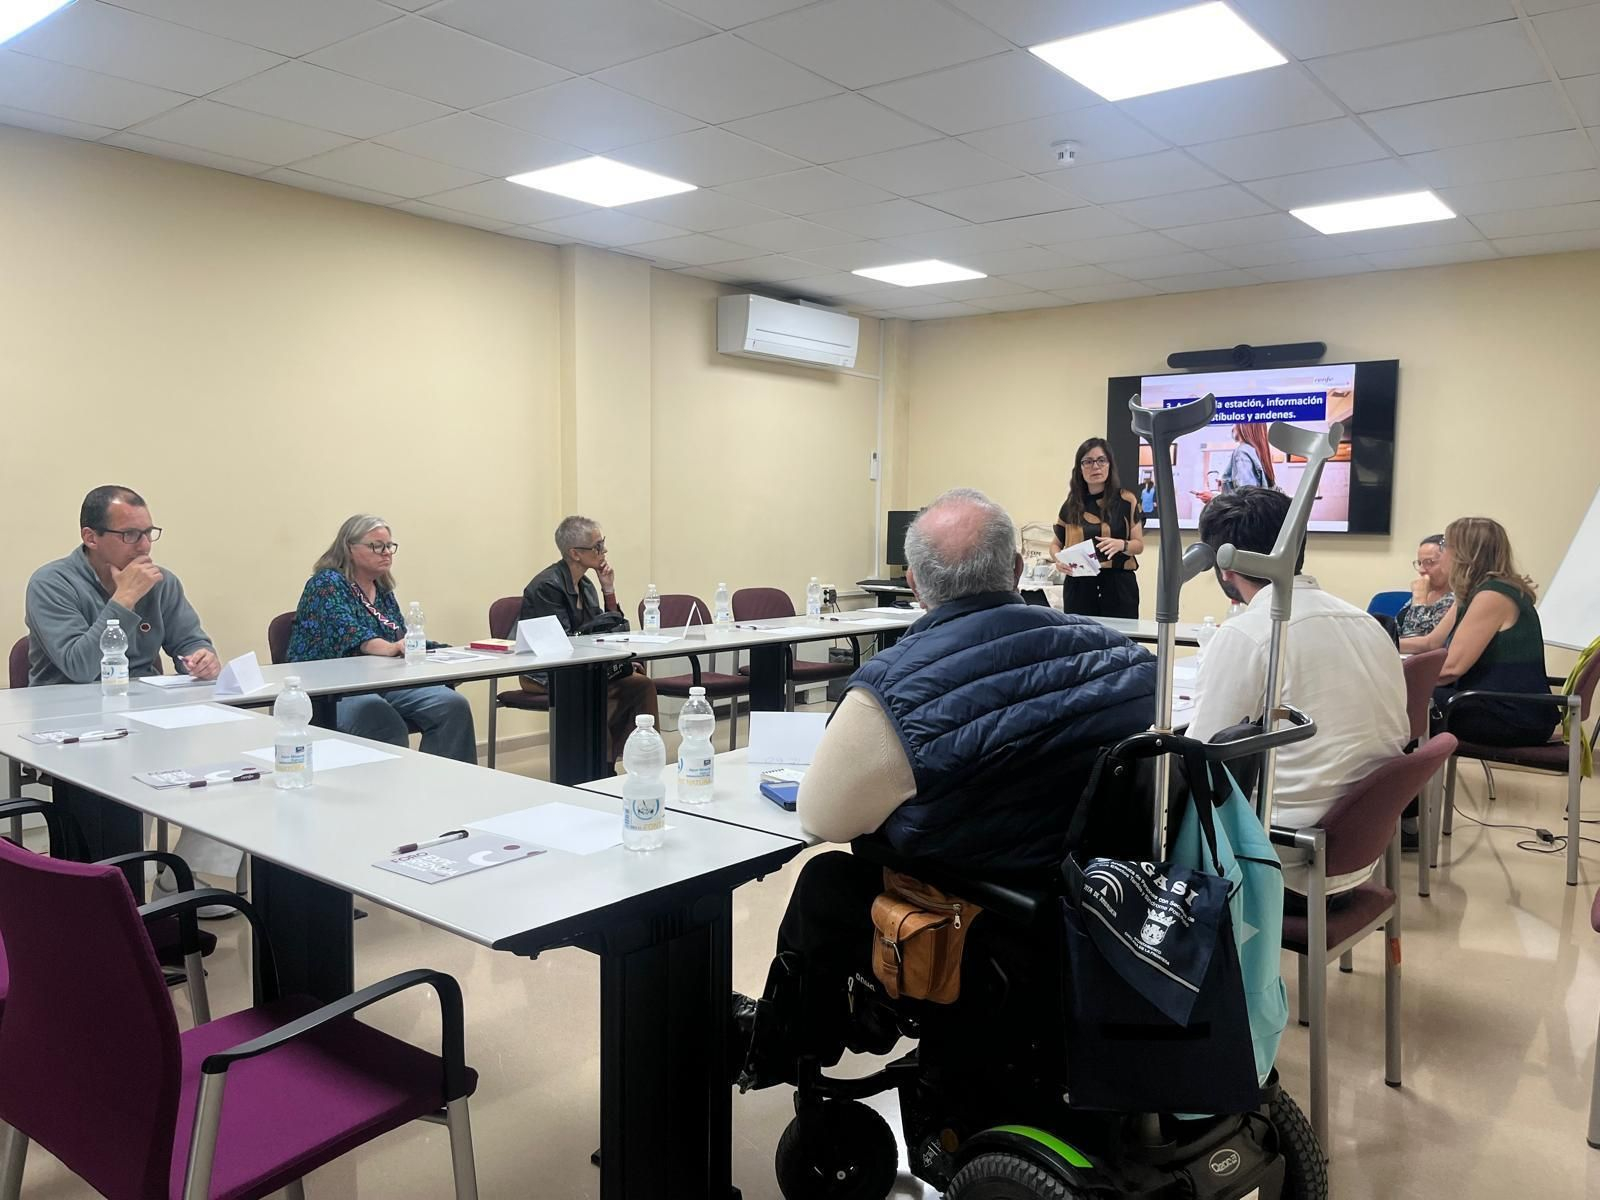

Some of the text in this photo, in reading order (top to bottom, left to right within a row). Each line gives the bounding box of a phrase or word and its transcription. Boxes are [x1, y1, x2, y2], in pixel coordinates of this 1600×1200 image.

[1224, 396, 1264, 409] estación,
[1266, 395, 1323, 407] información
[1247, 413, 1255, 422] y
[1255, 410, 1297, 420] andenes.
[1131, 861, 1199, 907] GASI
[1158, 897, 1169, 905] con
